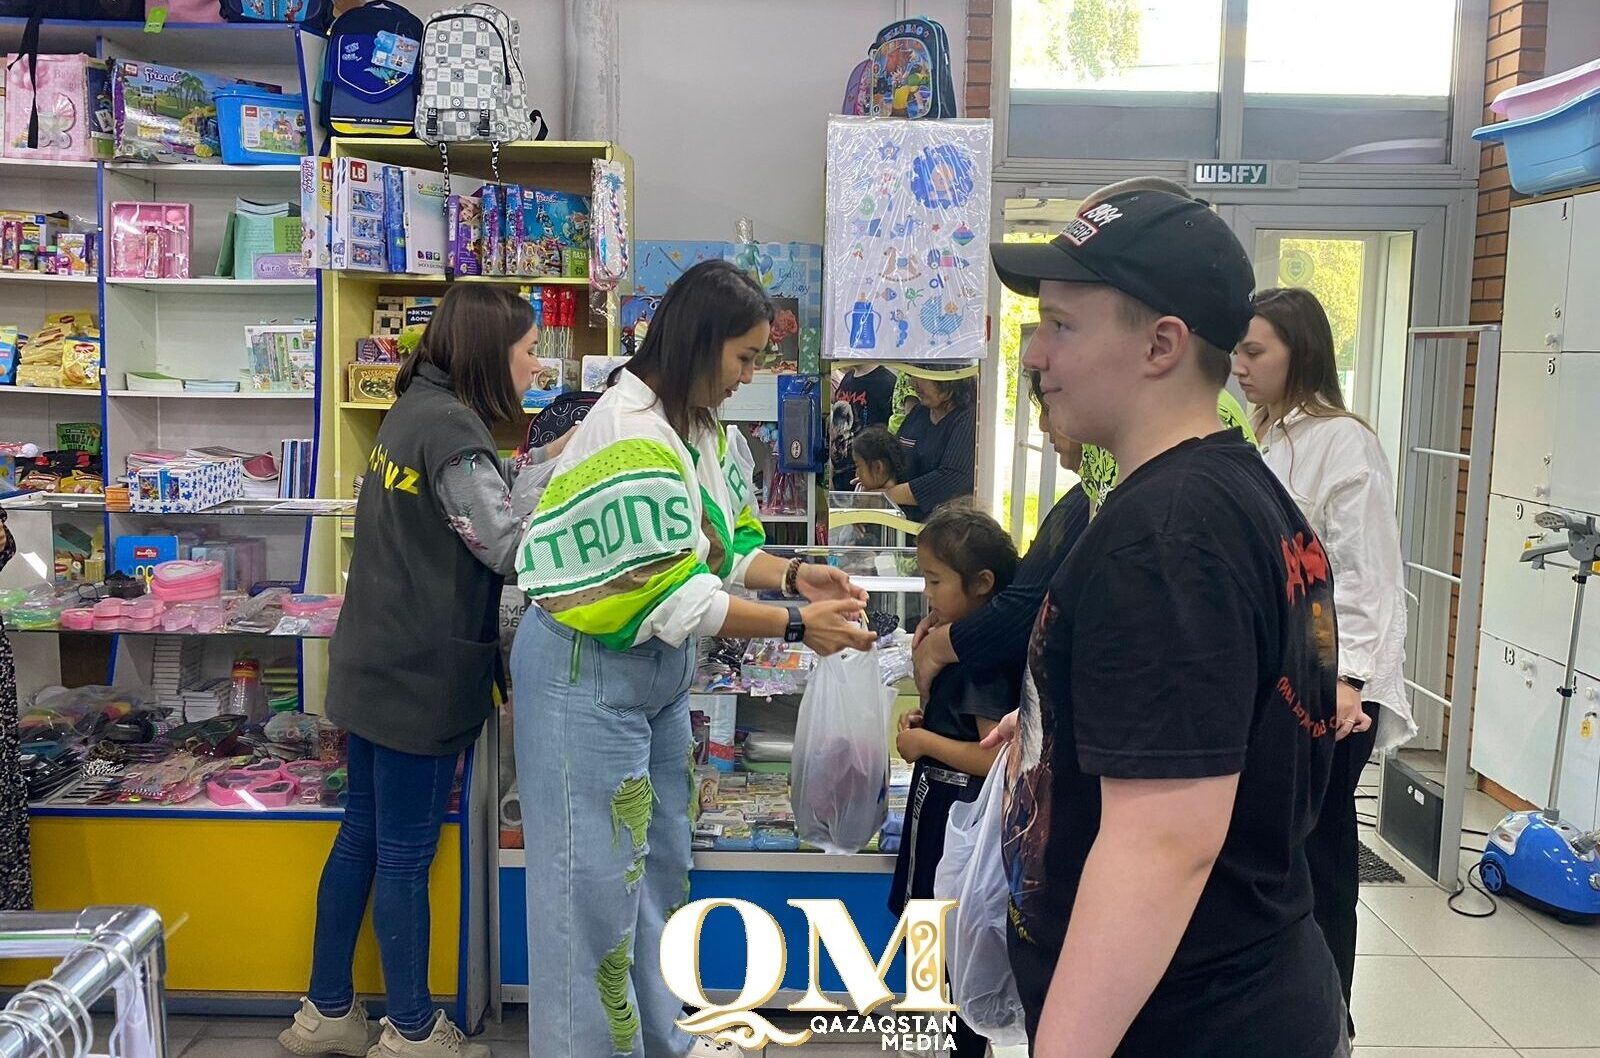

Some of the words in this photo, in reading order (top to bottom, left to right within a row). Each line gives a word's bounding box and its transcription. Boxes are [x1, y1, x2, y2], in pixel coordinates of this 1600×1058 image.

[1195, 164, 1264, 184] ШЫҒУ
[1561, 201, 1568, 220] 1
[1546, 357, 1556, 376] 5
[1515, 502, 1524, 520] 9
